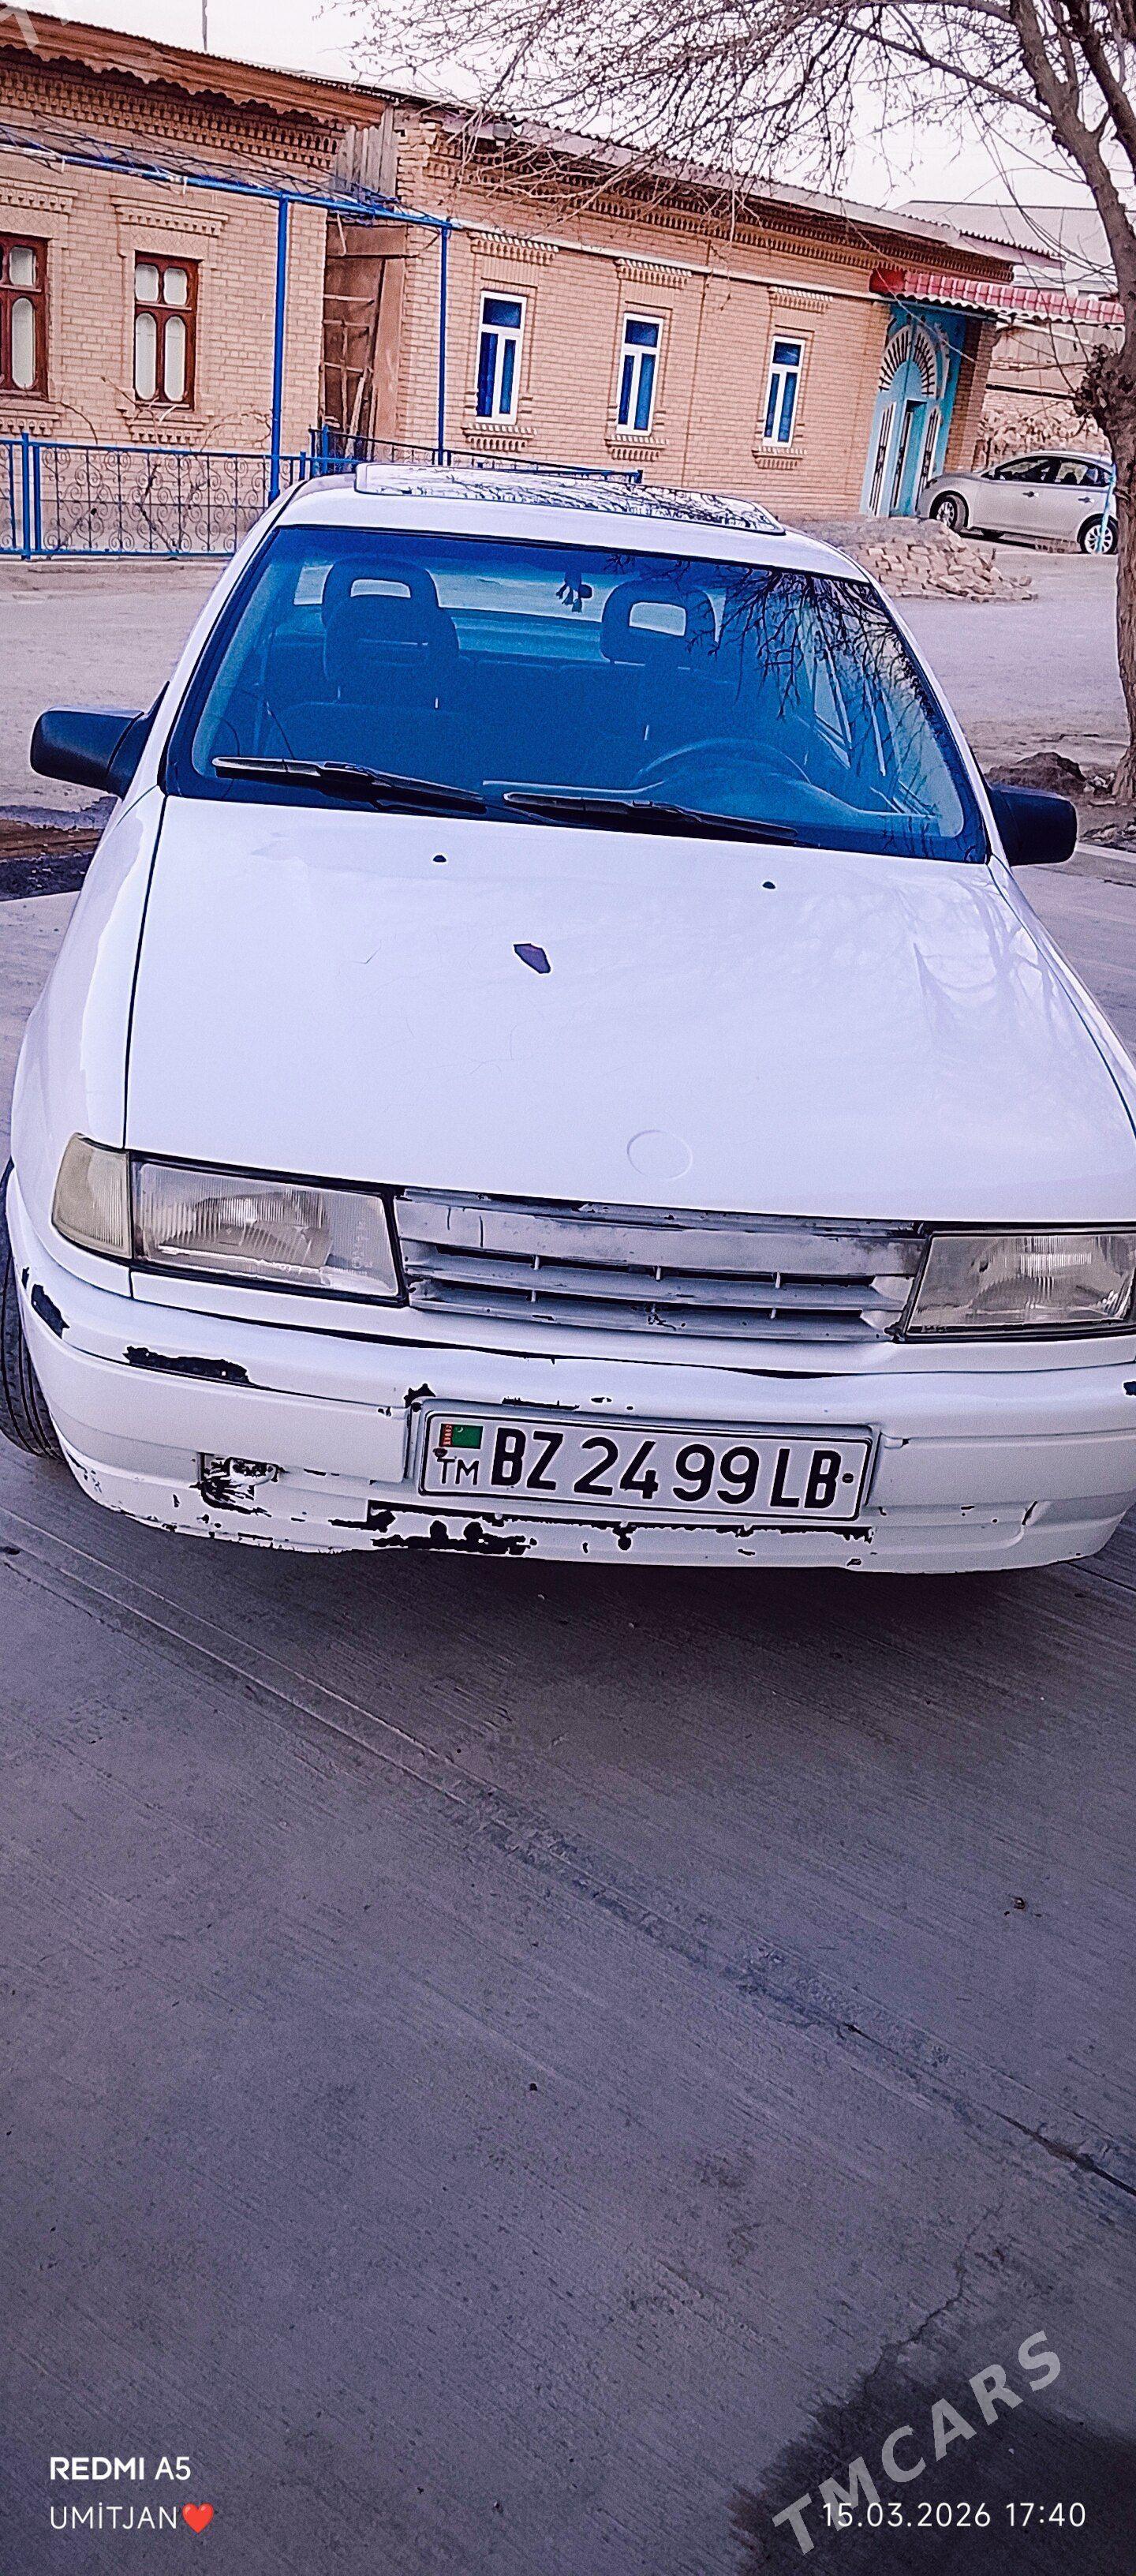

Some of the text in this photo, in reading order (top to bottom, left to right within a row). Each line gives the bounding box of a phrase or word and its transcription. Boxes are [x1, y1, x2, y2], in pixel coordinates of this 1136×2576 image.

[437, 1458, 480, 1485] TM
[491, 1427, 843, 1510] BZ 24 99 LB
